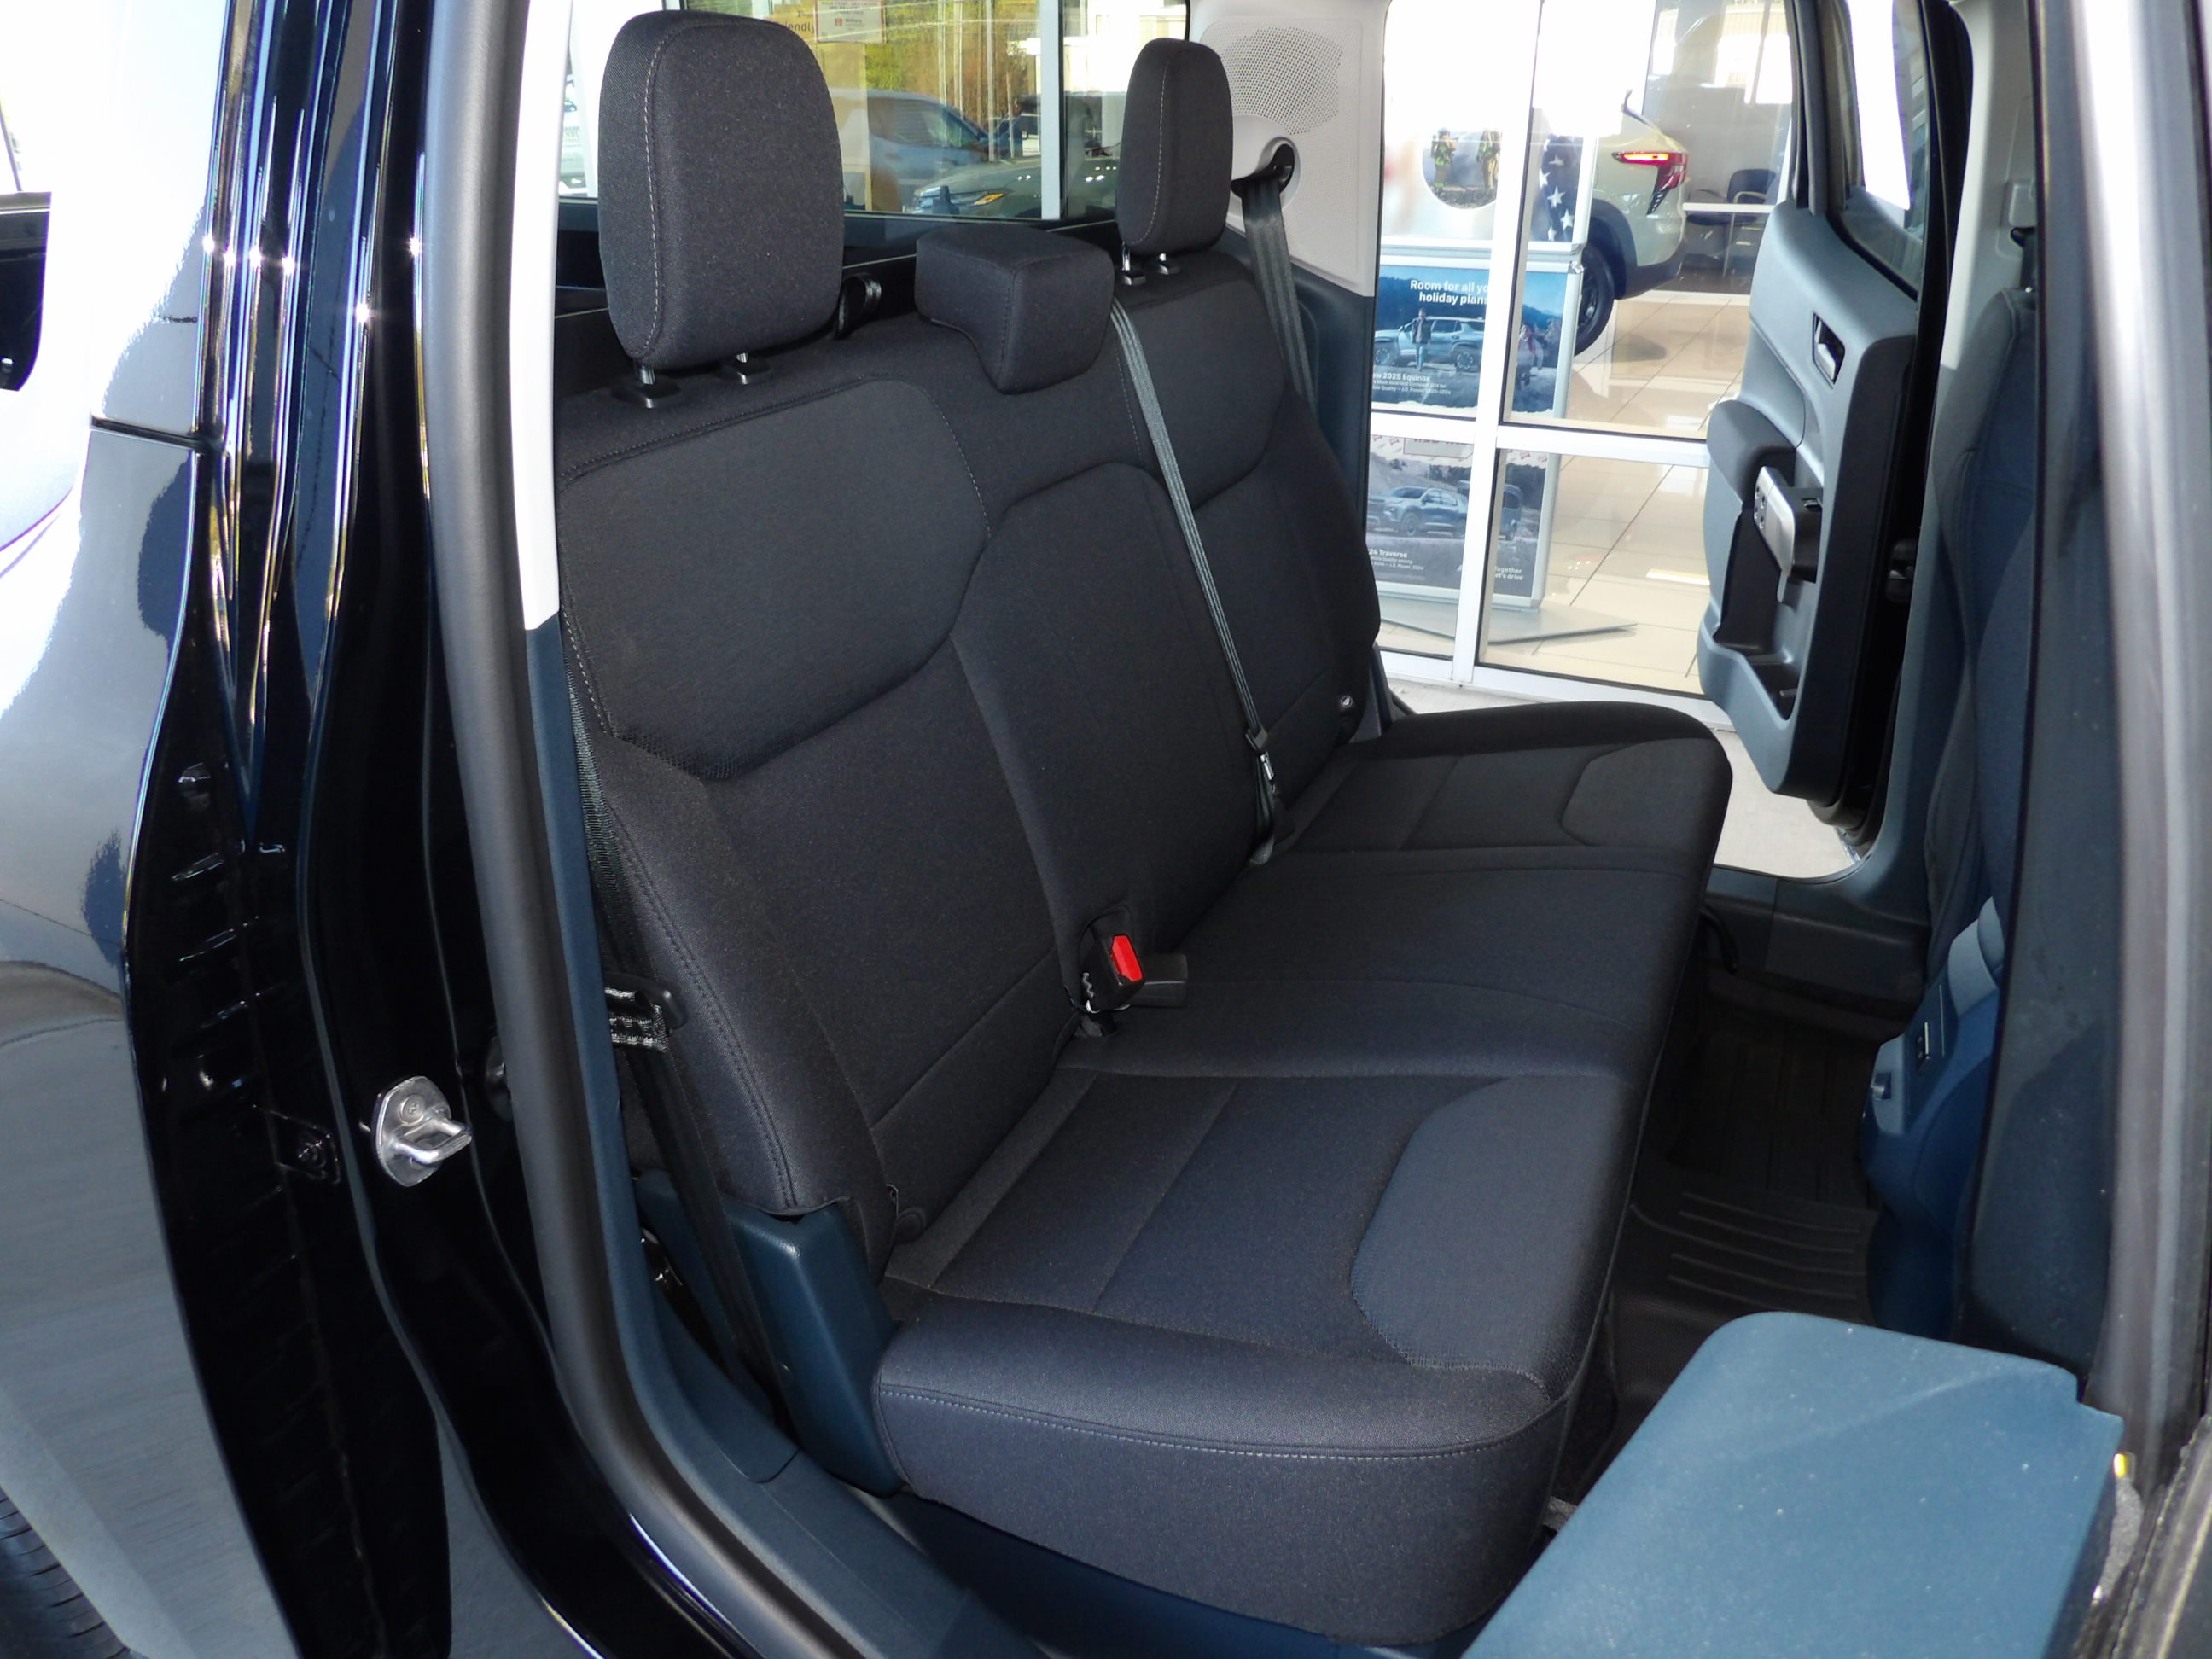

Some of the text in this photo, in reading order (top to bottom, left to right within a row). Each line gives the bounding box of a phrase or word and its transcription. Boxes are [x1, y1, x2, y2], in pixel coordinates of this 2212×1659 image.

[1410, 279, 1441, 291] Room
[1444, 280, 1460, 292] for
[1461, 282, 1475, 292] all
[1418, 291, 1458, 305] holiday
[1402, 374, 1430, 382] Equinox
[1379, 549, 1408, 558] Traverse
